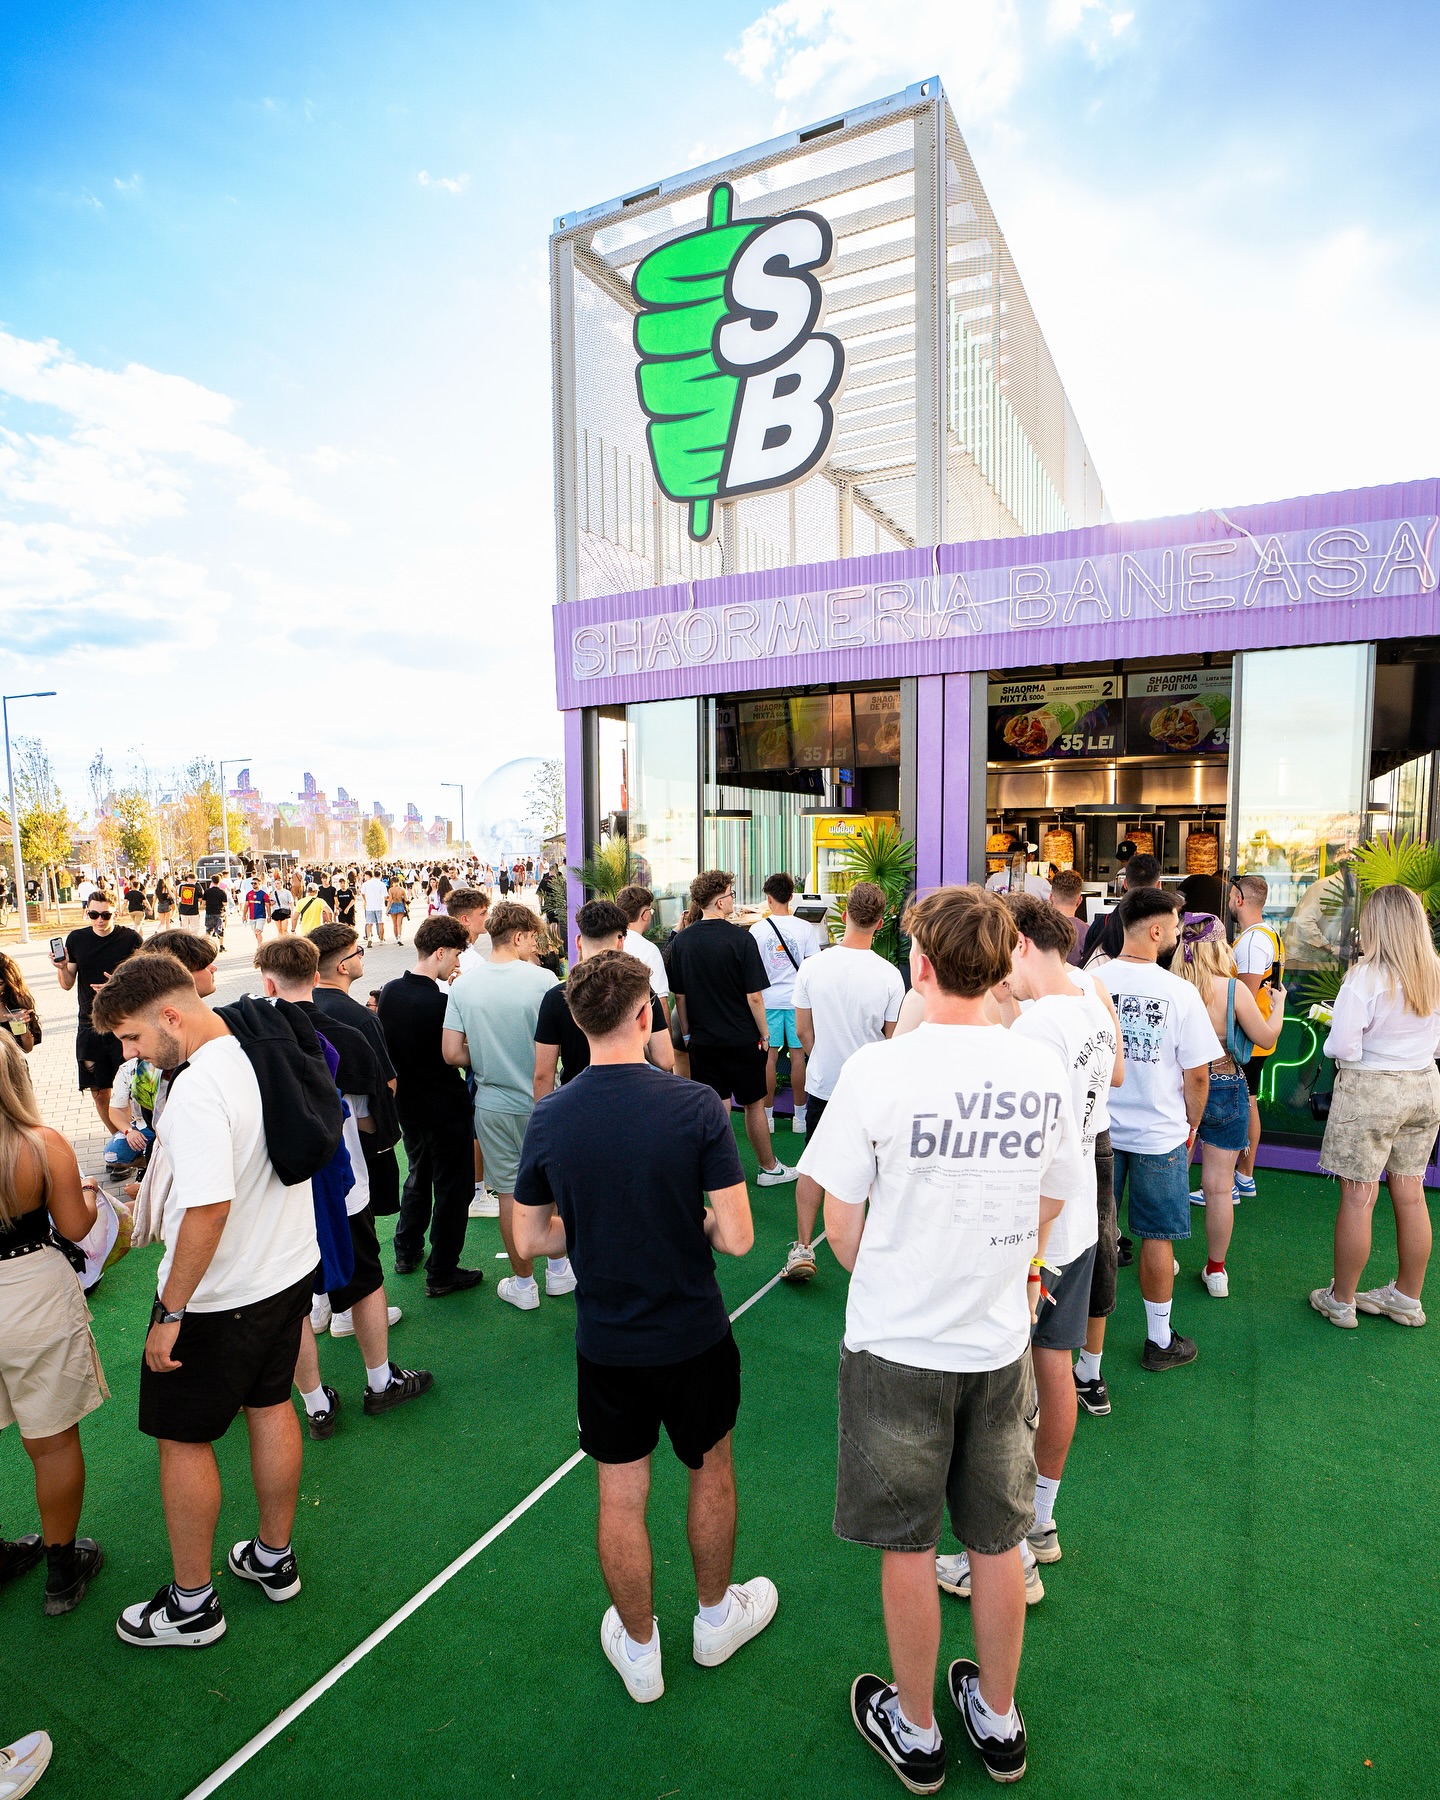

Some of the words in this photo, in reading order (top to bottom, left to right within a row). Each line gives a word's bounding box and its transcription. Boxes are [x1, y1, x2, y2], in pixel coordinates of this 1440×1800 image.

[573, 574, 983, 677] SHAORMERIA
[1009, 521, 1437, 628] BANEASA
[1149, 674, 1198, 685] SHAORMA
[1101, 681, 1114, 696] 2
[1146, 684, 1159, 693] DE
[1161, 683, 1178, 692] PUI
[1060, 733, 1084, 751] 35
[1087, 735, 1115, 750] LEI
[803, 746, 822, 762] 35
[955, 1080, 1062, 1120] vison
